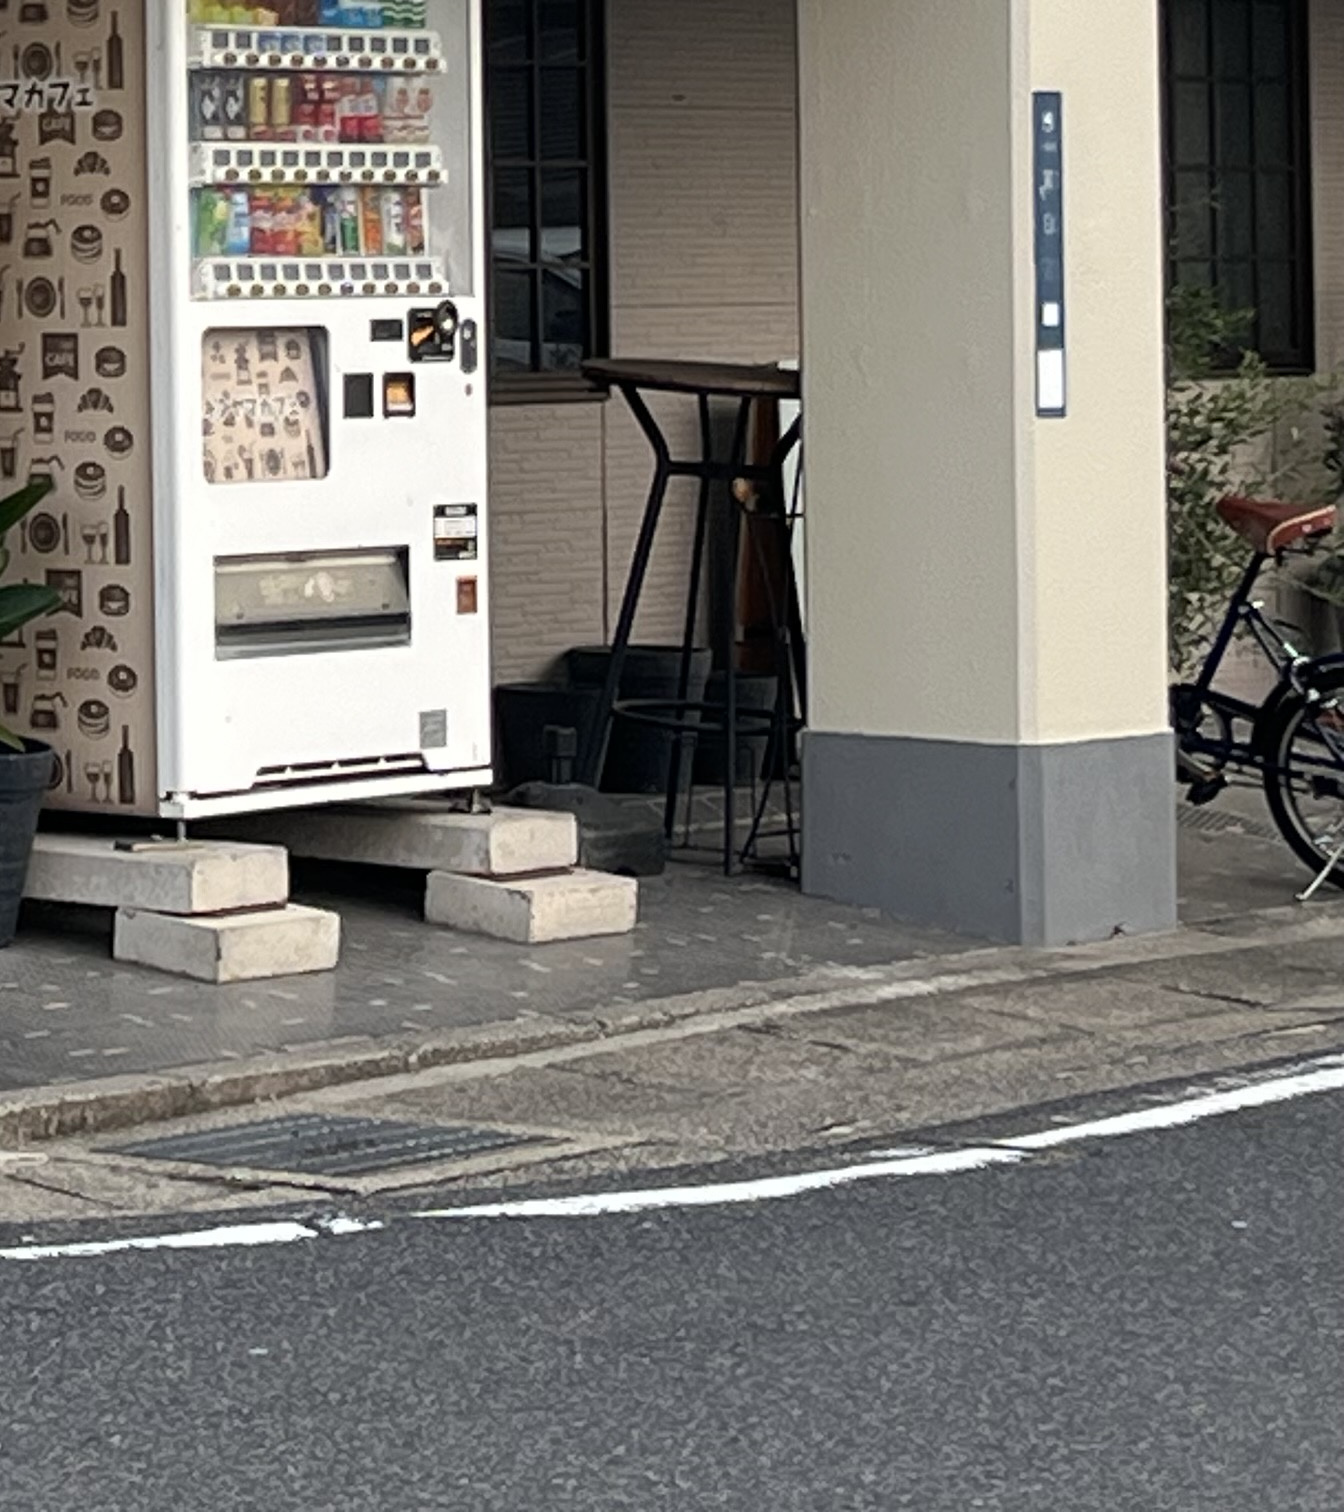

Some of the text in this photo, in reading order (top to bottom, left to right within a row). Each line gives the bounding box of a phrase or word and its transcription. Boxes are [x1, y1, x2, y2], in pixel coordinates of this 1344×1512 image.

[61, 194, 94, 206] FOOD
[64, 430, 97, 443] FOOD
[67, 666, 101, 681] FOOD
